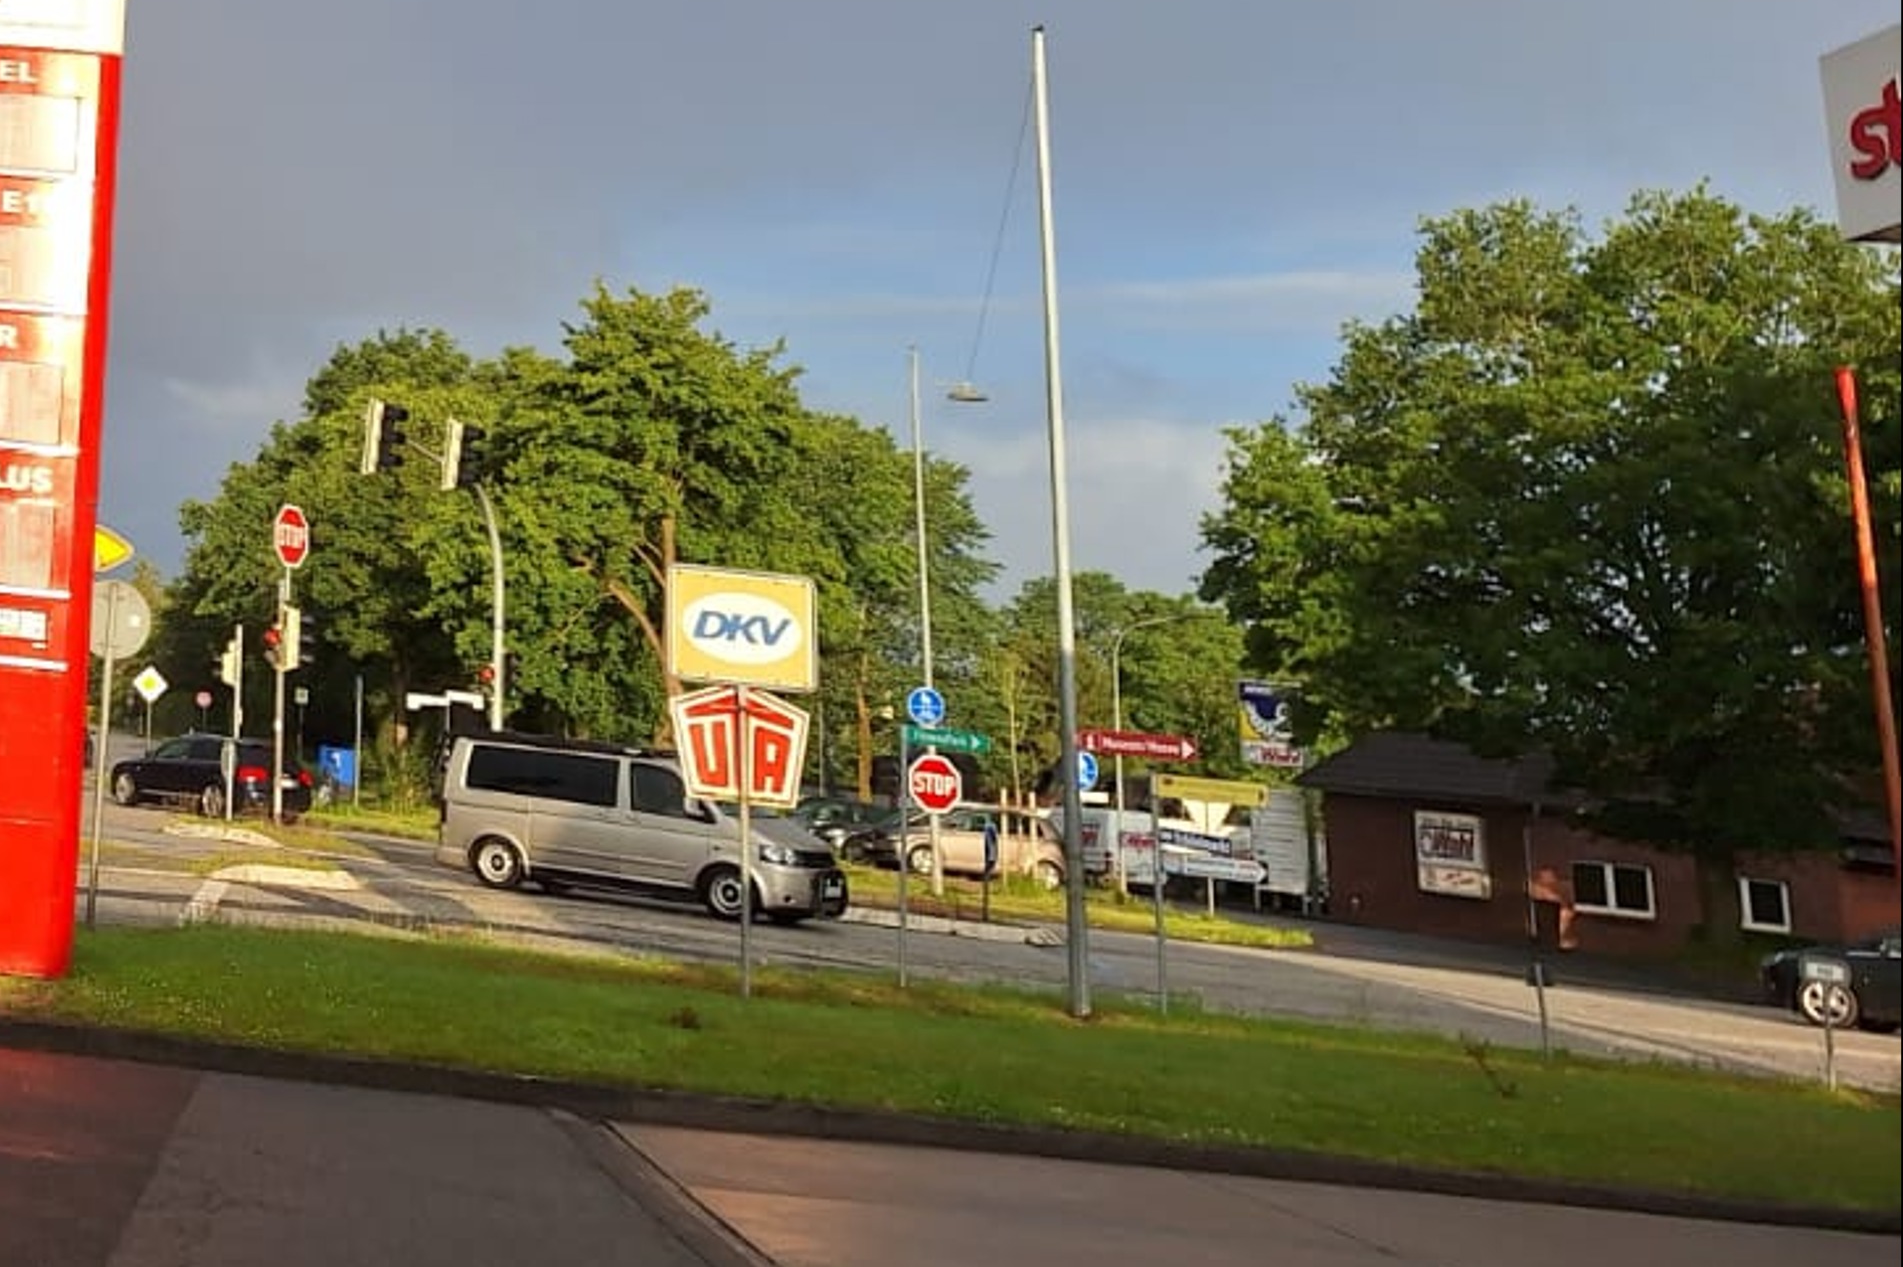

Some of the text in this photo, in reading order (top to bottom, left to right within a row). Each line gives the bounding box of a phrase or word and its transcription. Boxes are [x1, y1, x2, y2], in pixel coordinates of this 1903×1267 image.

[279, 524, 306, 549] STOP
[693, 610, 791, 646] DKV
[913, 771, 956, 798] STOP
